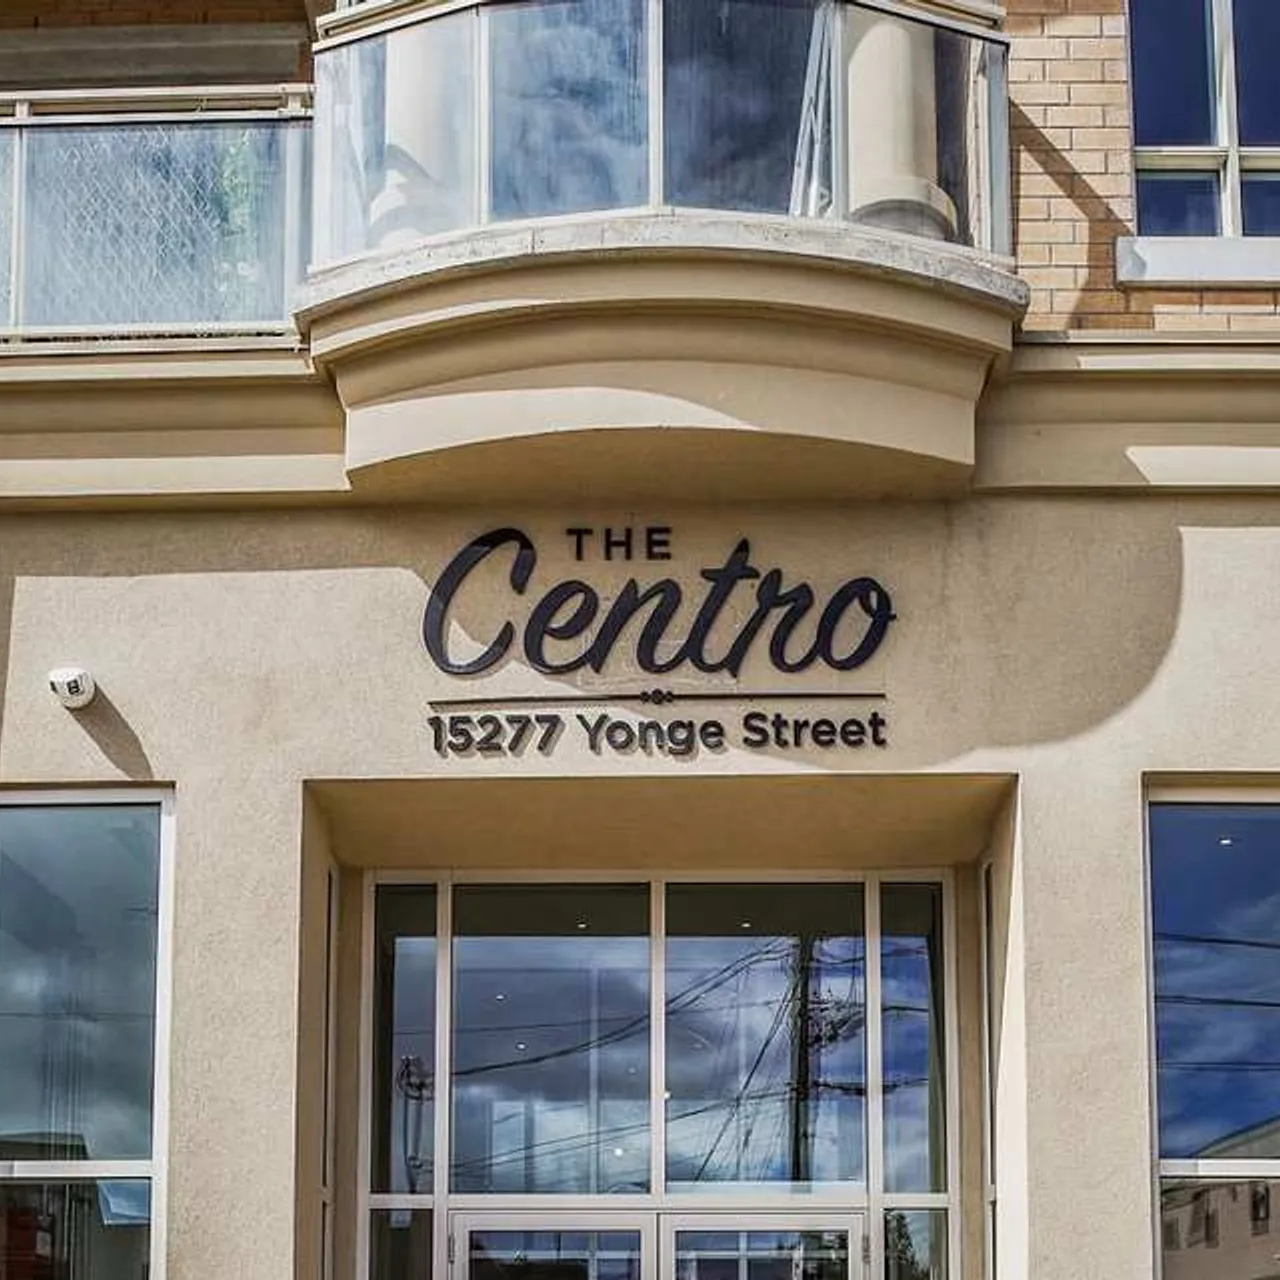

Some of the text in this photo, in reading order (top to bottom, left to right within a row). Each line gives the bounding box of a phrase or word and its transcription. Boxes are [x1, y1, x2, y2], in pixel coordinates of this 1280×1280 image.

[565, 526, 673, 561] THE
[422, 526, 897, 677] Centro
[427, 710, 887, 757] 15277 Yonge Street
